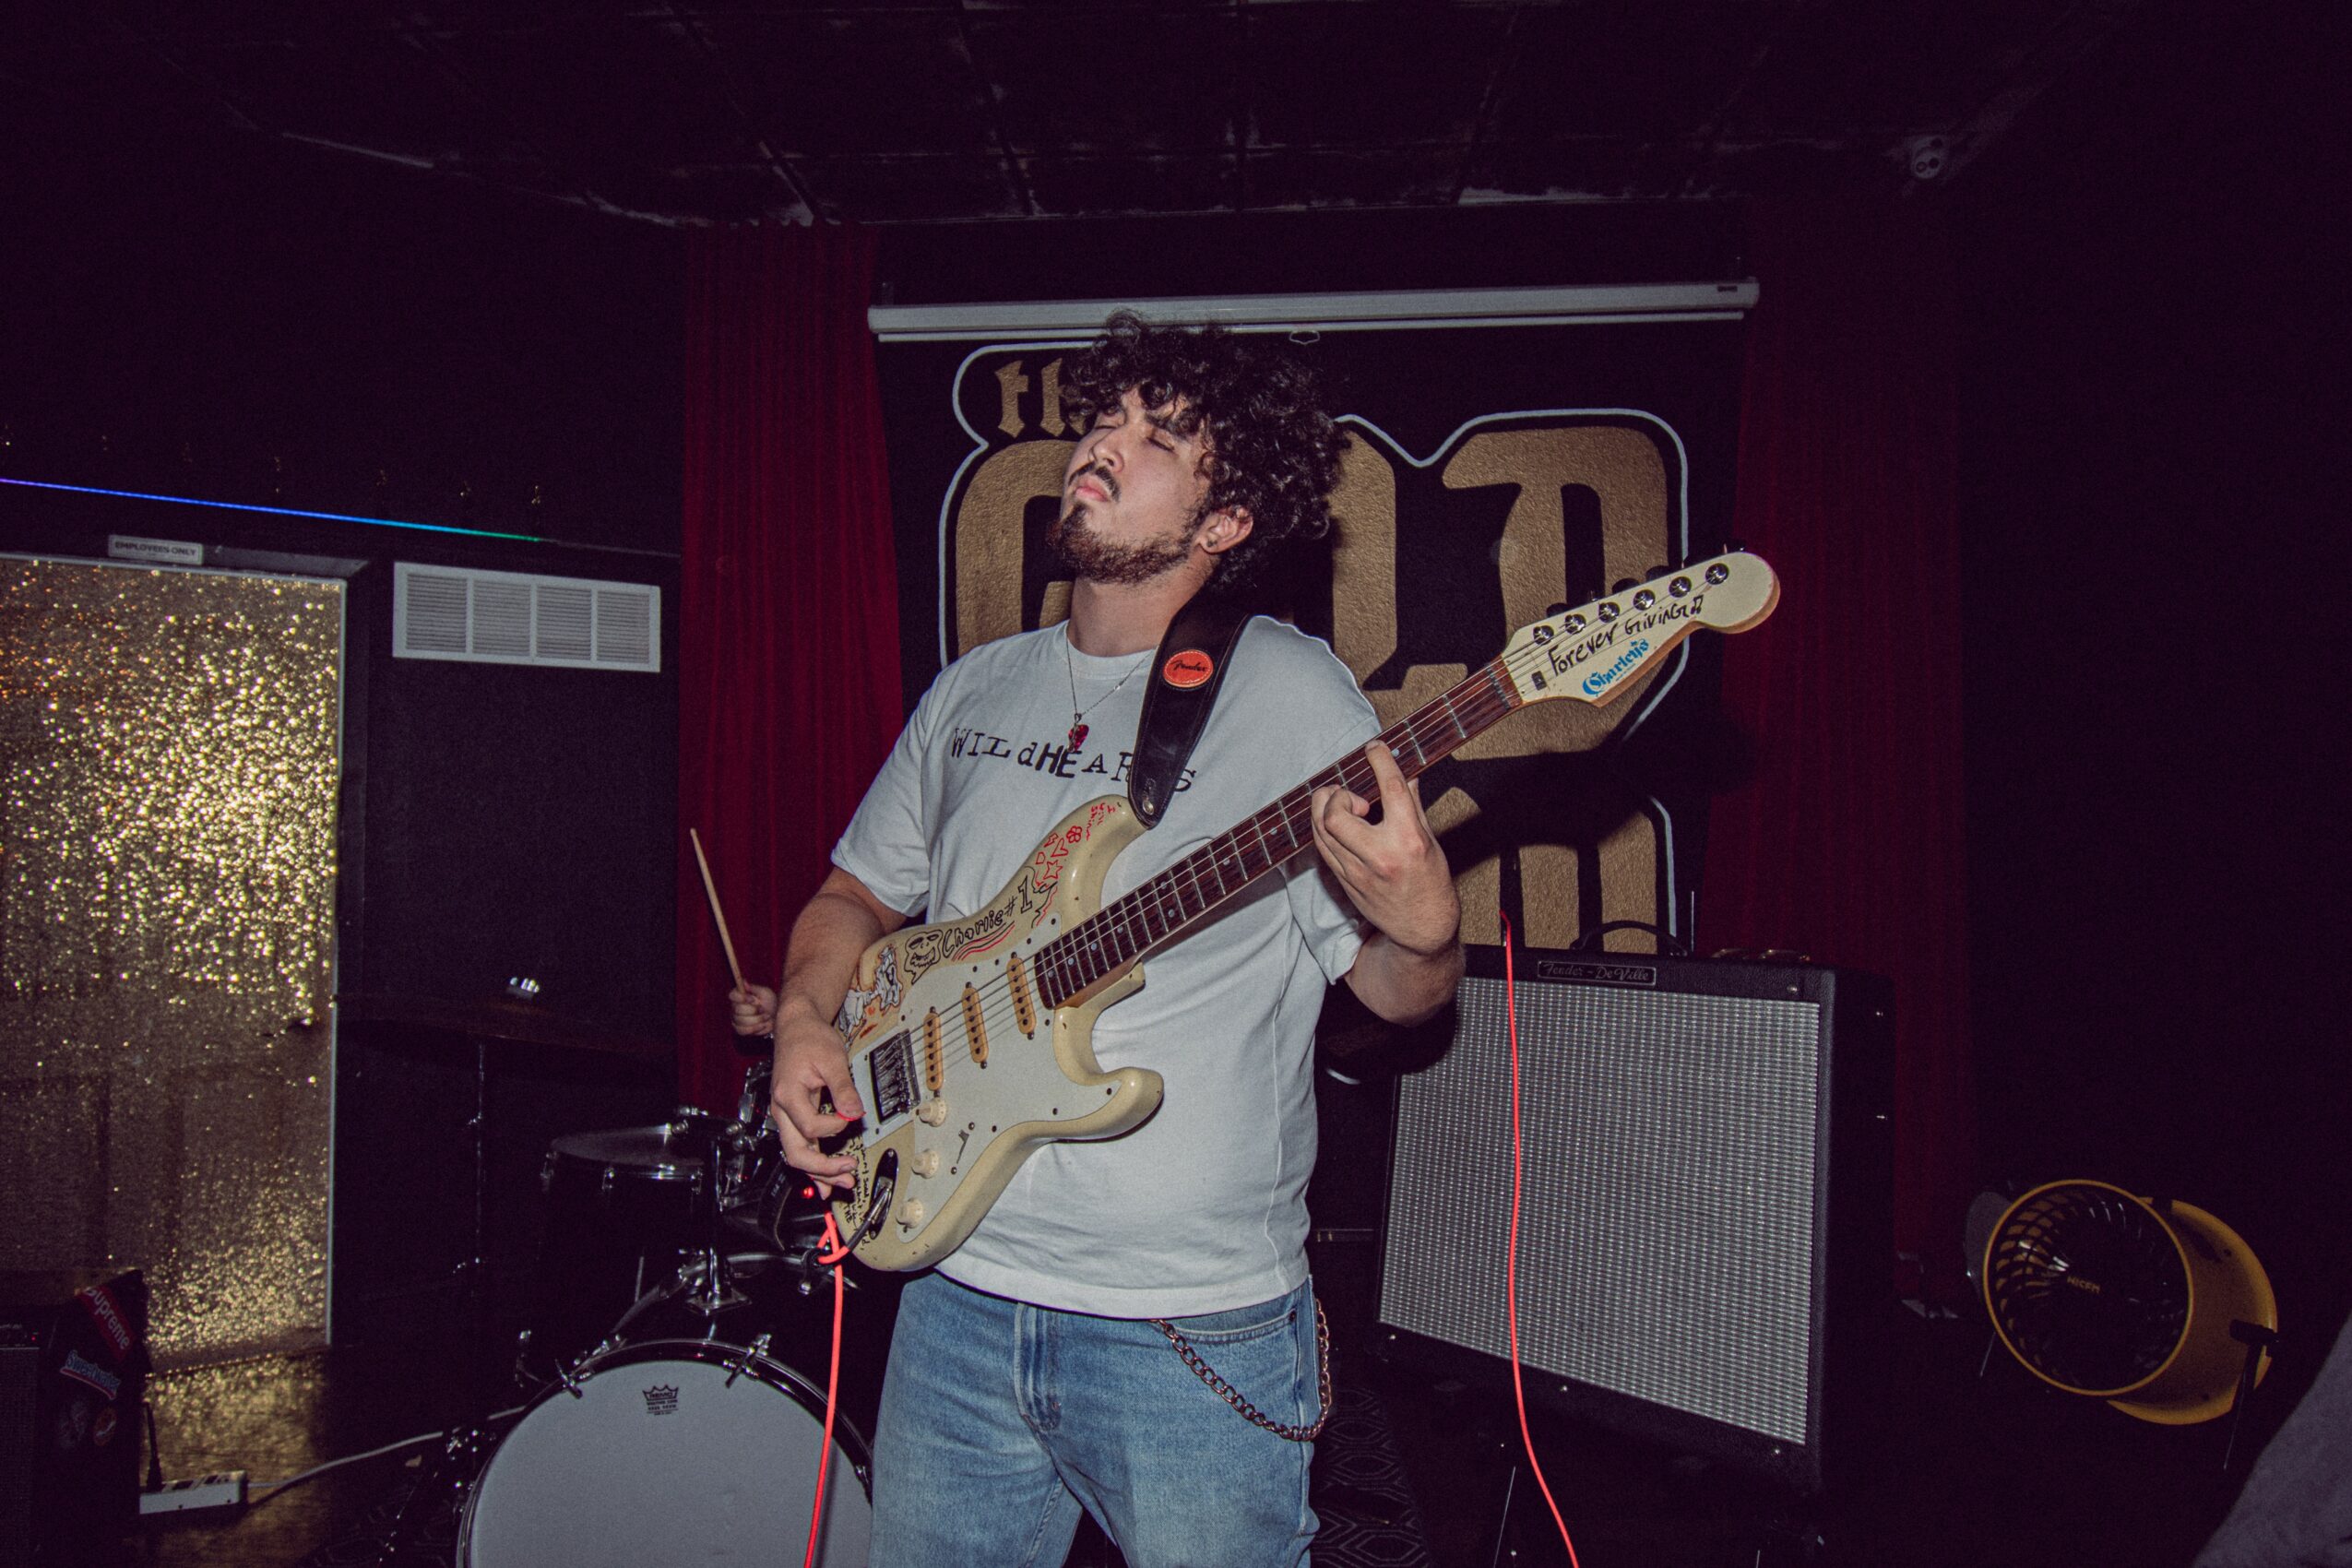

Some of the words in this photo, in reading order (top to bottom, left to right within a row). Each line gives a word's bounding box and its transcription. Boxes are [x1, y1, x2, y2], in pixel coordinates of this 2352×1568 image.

[994, 356, 1087, 438] th
[114, 540, 170, 553] EMPLOYEES
[171, 546, 197, 556] ONLY
[1170, 659, 1207, 672] Fender
[1548, 622, 1619, 676] Forever
[1543, 963, 1584, 977] Fender
[85, 1287, 131, 1350] Supreme
